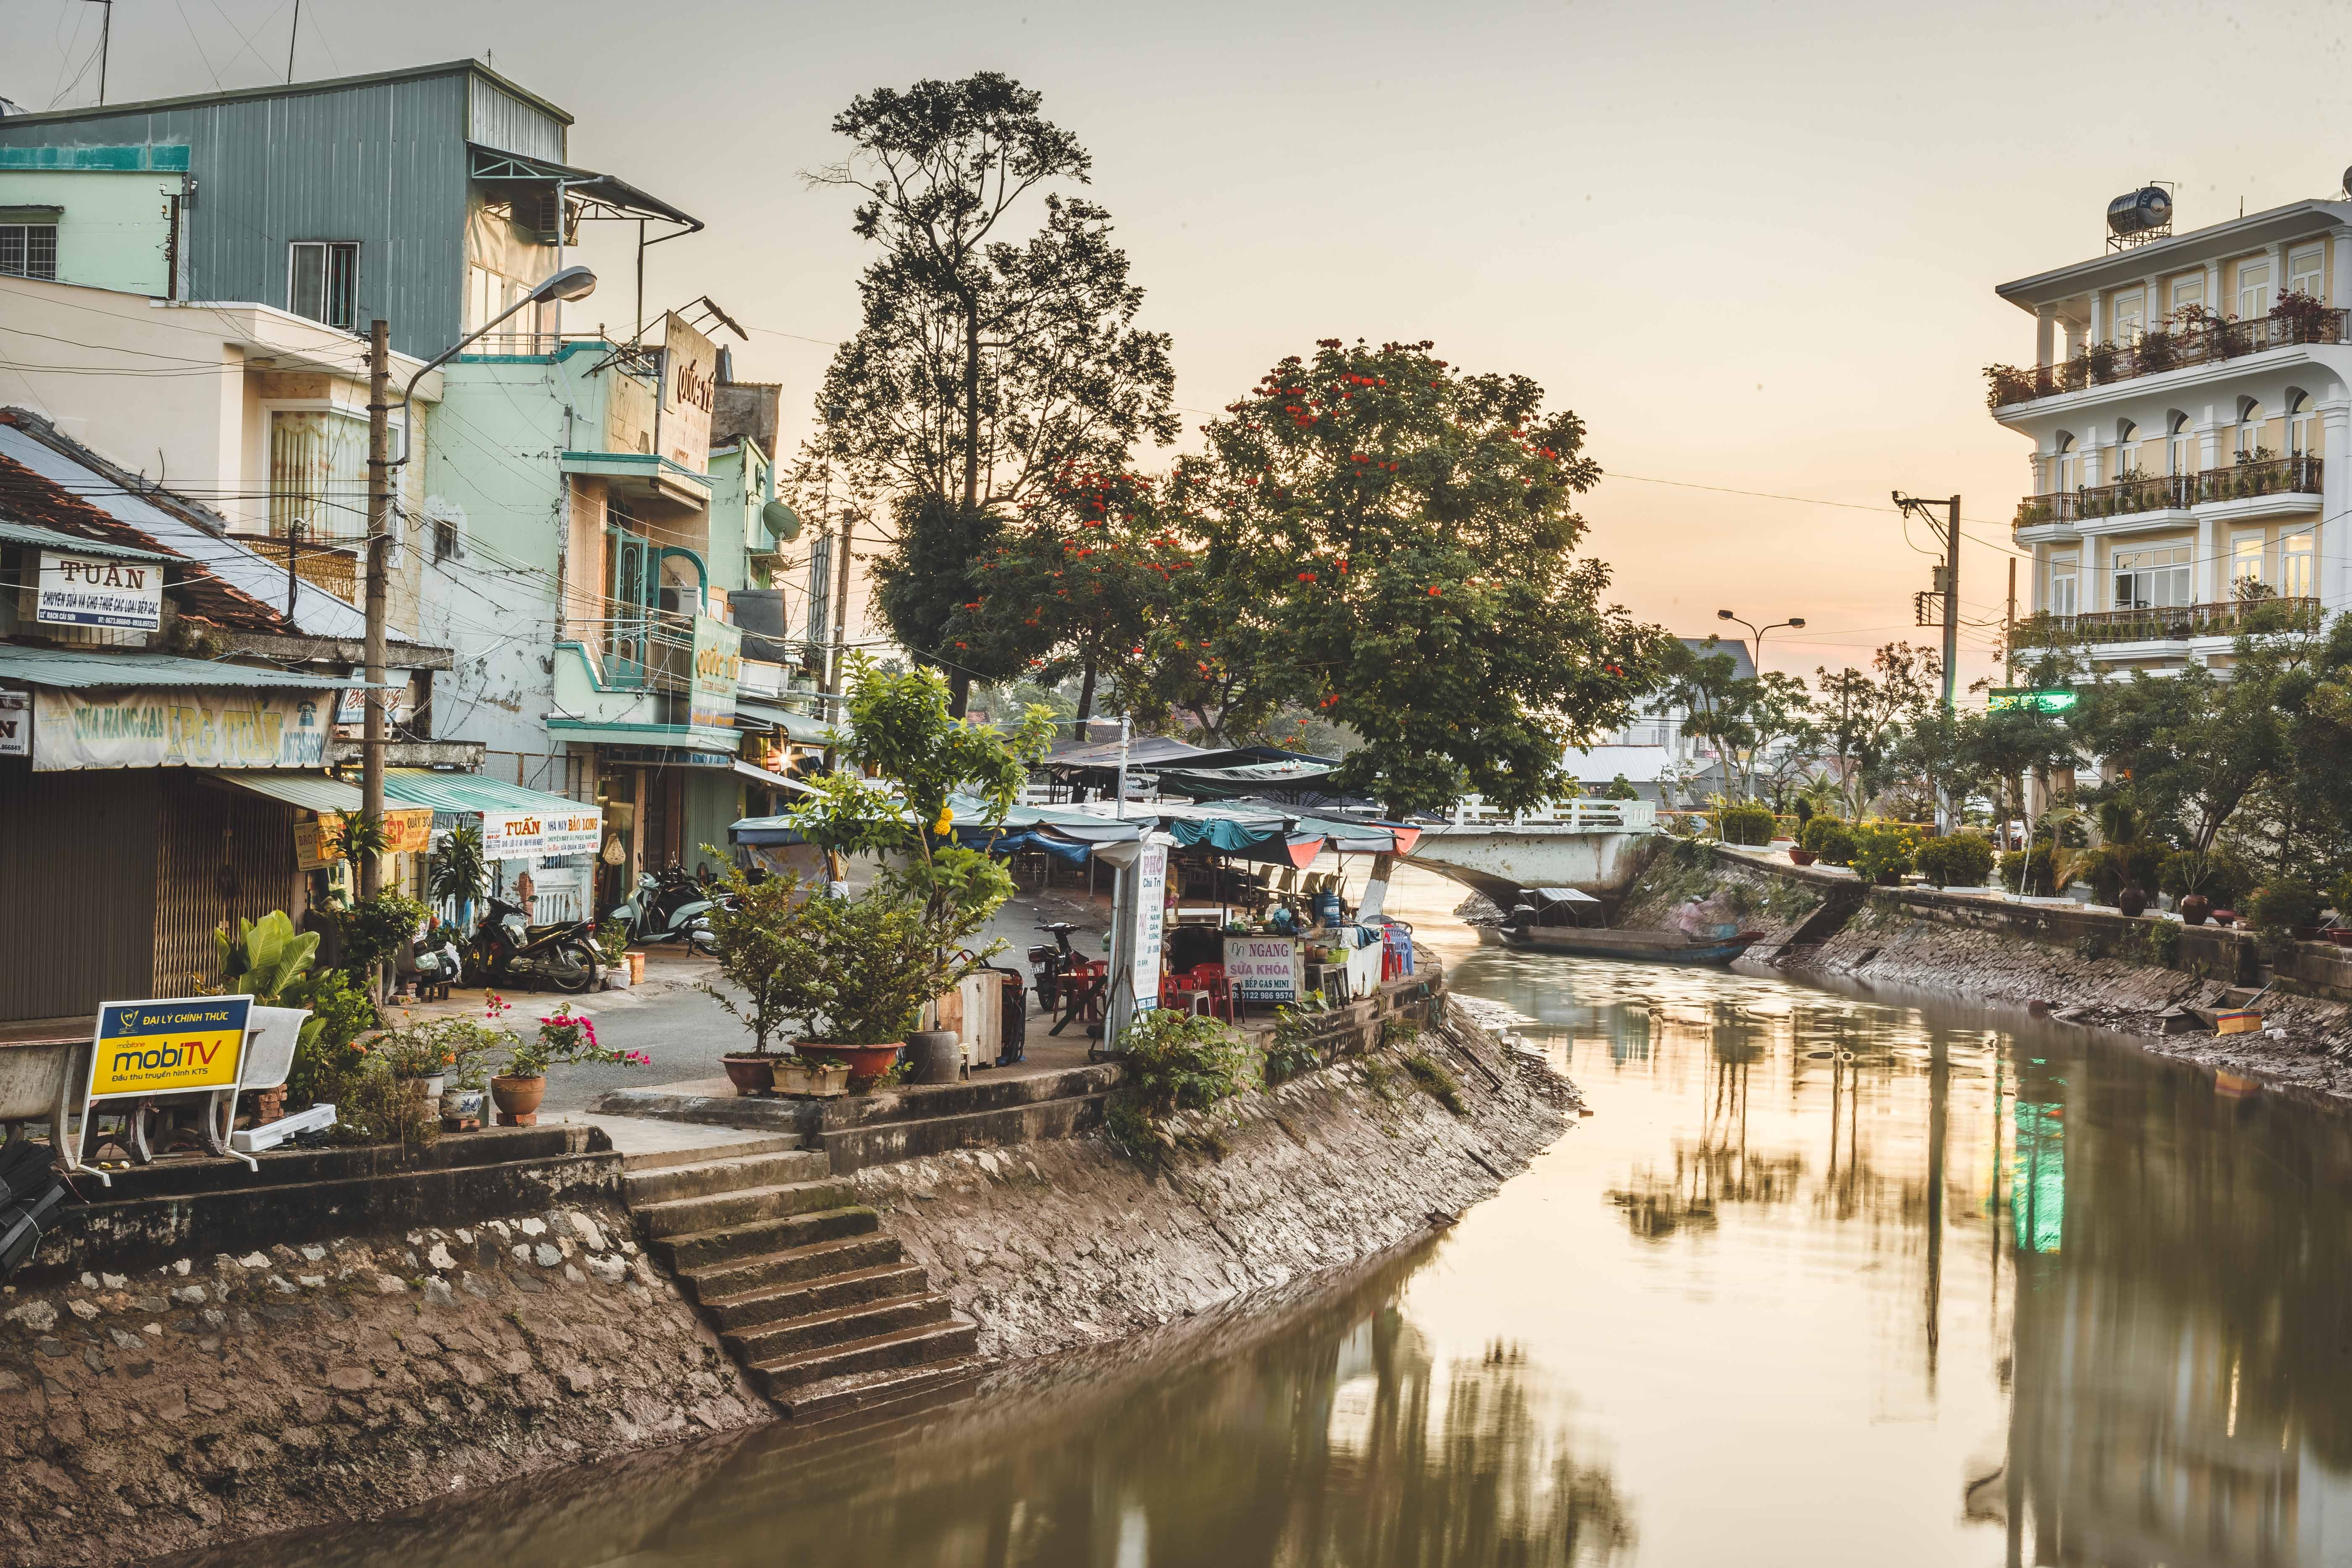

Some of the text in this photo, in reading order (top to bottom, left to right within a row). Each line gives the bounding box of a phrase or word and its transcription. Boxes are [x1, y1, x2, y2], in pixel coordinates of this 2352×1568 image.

[677, 359, 715, 414] QUỐC TẾ
[60, 559, 145, 589] TUẤN
[43, 589, 65, 607] CHUYÊN
[86, 595, 97, 610] CHO
[99, 594, 113, 612] THUÊ
[114, 594, 124, 613] CÁC
[138, 595, 148, 614] BẾP
[148, 601, 158, 615] GAS
[696, 641, 724, 678] QUỐC
[140, 707, 164, 738] GAS
[505, 817, 541, 835] TUẤN
[547, 818, 556, 831] NHÀ
[568, 814, 580, 831] BẢO
[582, 817, 598, 830] LONG
[1143, 877, 1152, 888] Chú
[1249, 944, 1289, 957] NGANG
[1230, 961, 1253, 974] SỬA
[1245, 976, 1257, 988] BẾP
[143, 1009, 229, 1026] ĐẠI LÝ CHÍNH THỨC
[116, 1040, 145, 1049] mobifone
[113, 1040, 222, 1072] mobiTV
[173, 1069, 189, 1077] hình
